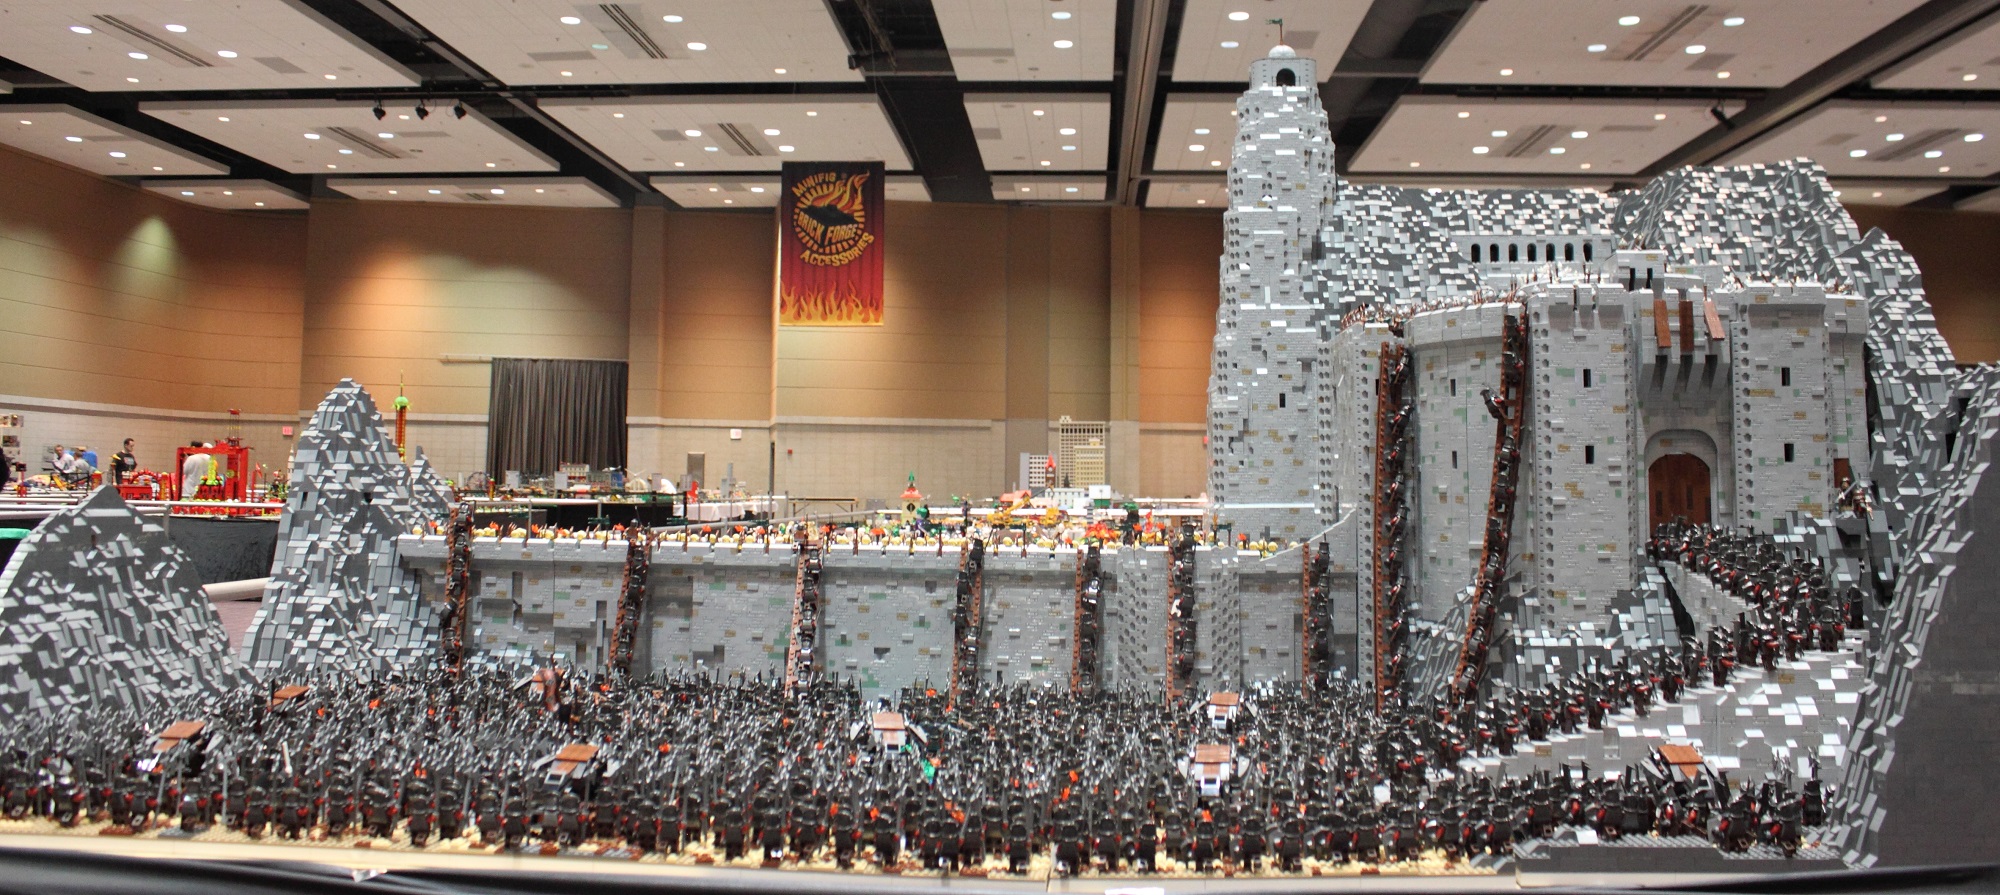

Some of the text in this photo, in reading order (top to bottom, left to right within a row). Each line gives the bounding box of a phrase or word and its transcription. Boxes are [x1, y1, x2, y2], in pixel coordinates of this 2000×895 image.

[791, 172, 836, 197] MINIFIG
[797, 211, 858, 246] BRICK FORGE
[800, 232, 875, 267] ACCESSORIES
